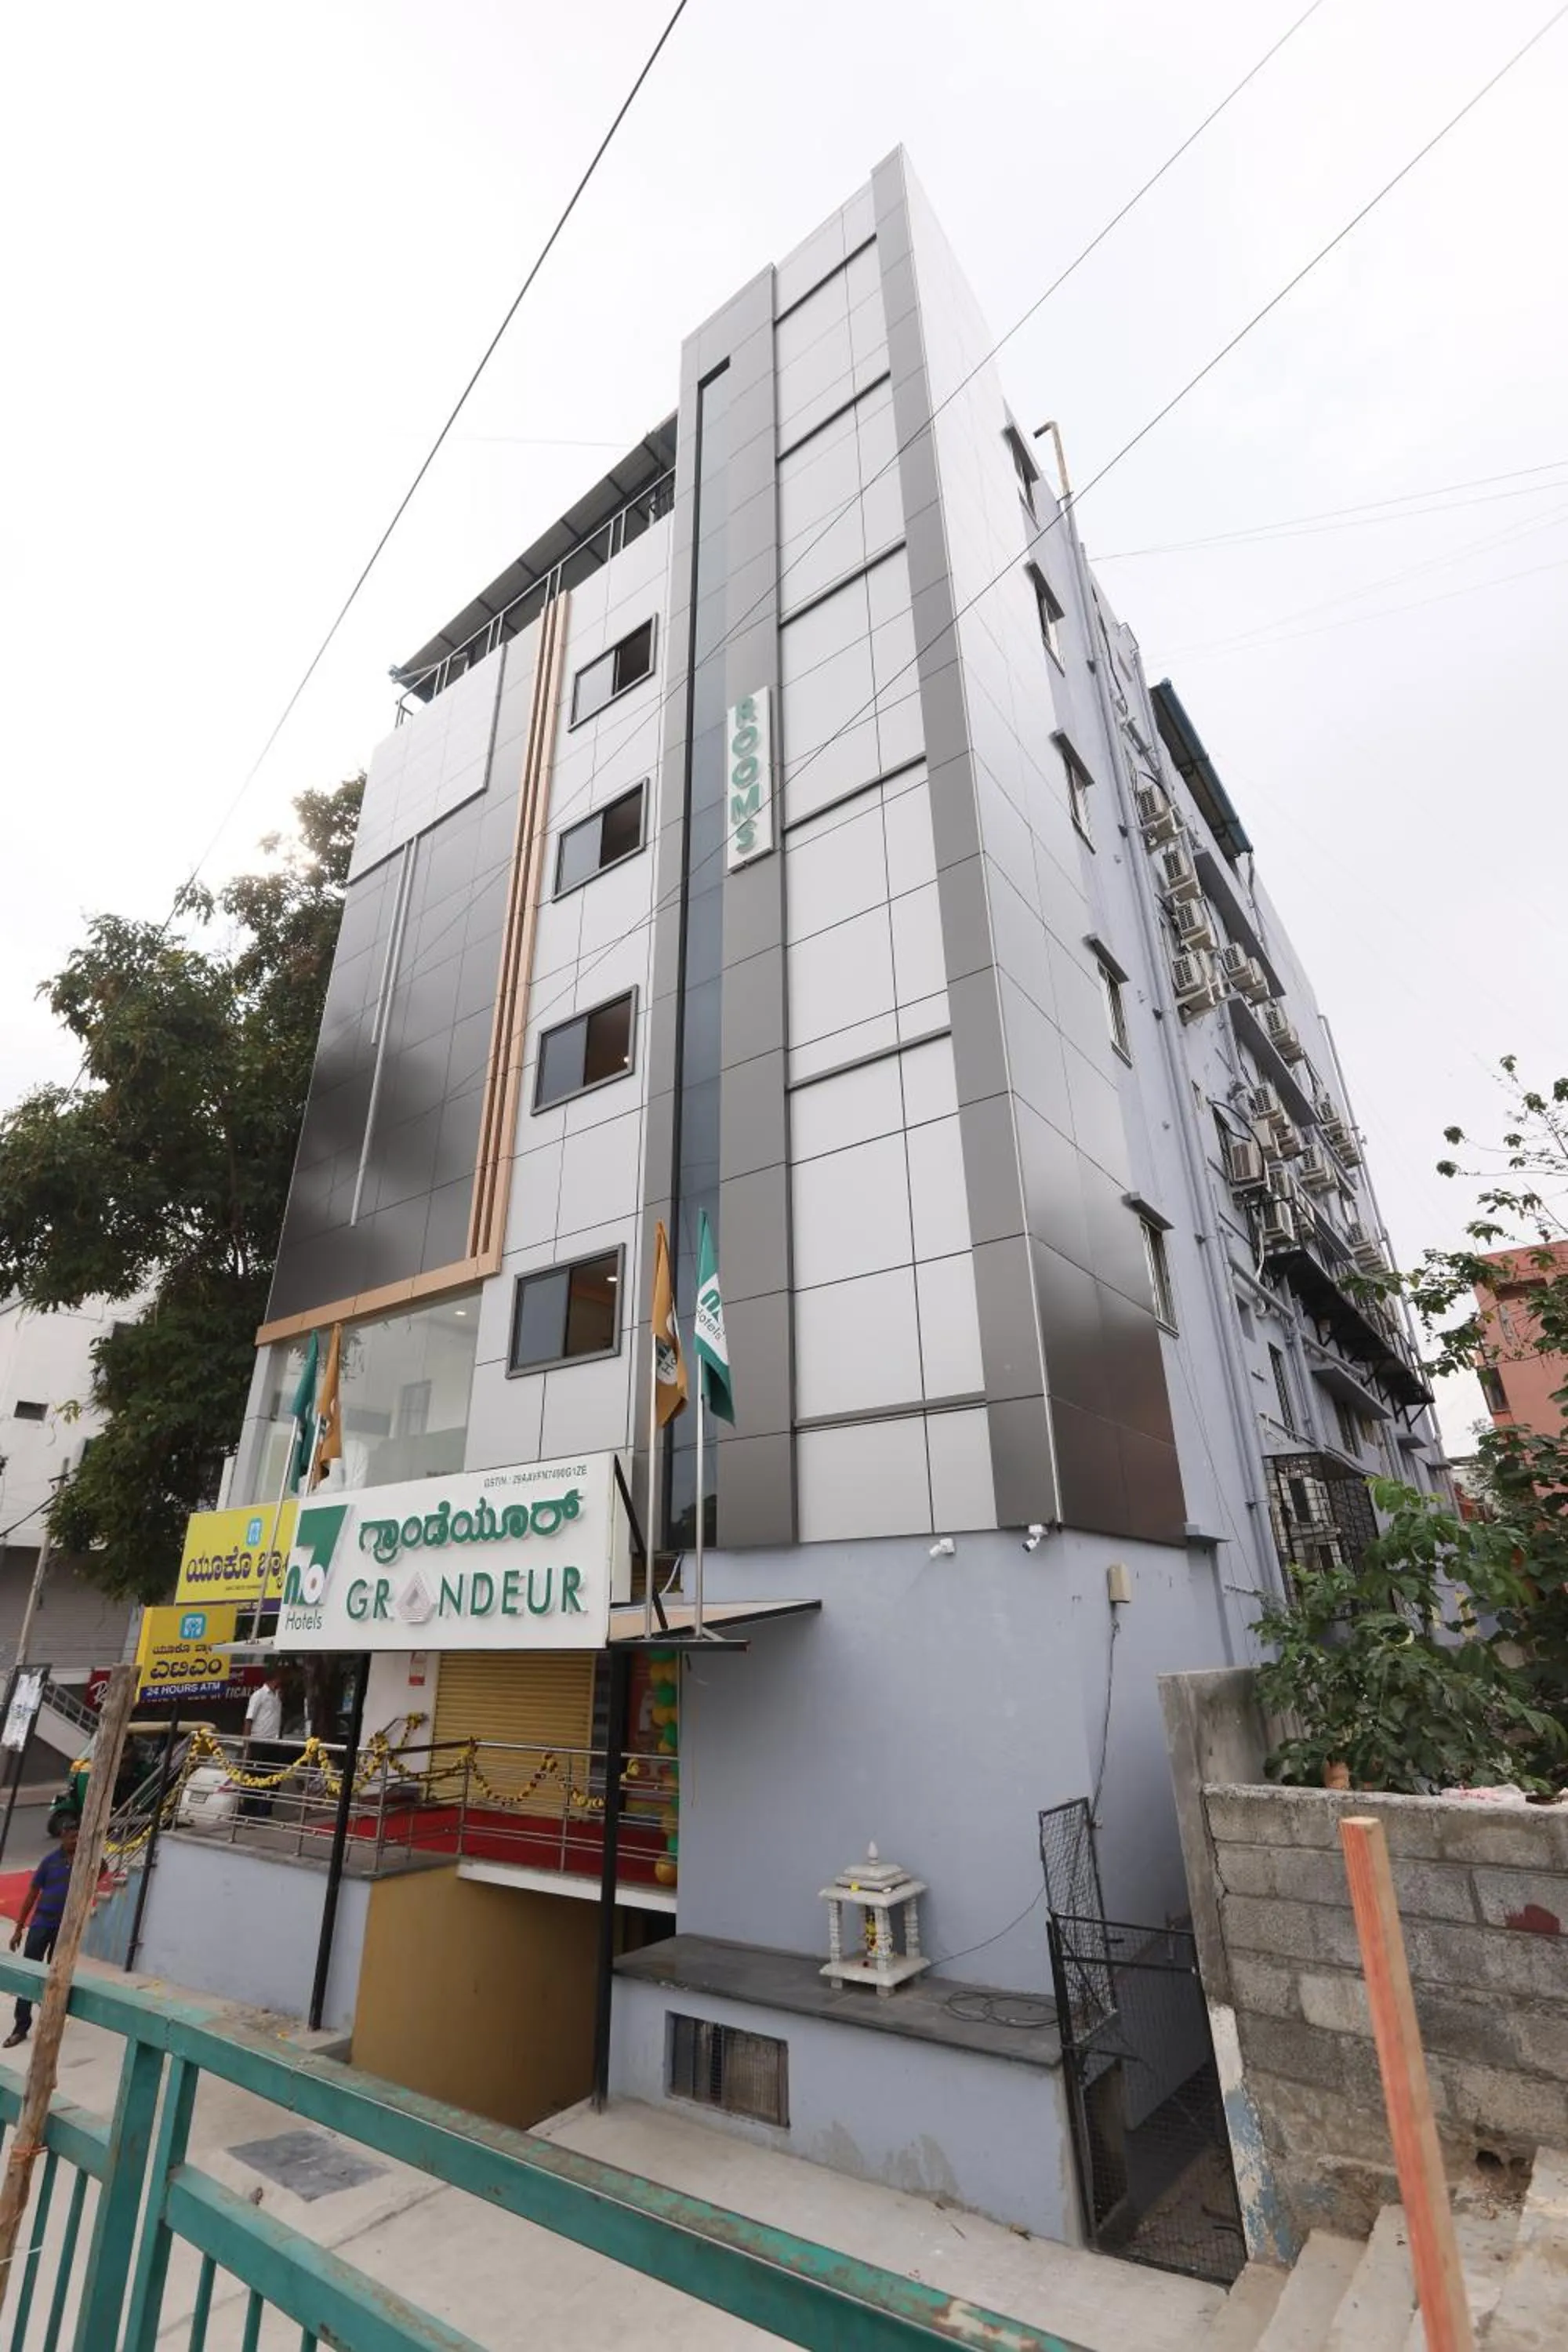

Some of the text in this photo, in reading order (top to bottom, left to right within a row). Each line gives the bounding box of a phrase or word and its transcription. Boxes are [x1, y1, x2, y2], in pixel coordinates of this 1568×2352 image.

[731, 695, 761, 854] ROOMS
[347, 1566, 582, 1624] GRANDEUR
[285, 1610, 322, 1631] Hotels
[147, 1682, 220, 1697] 24 HOURS ATM
